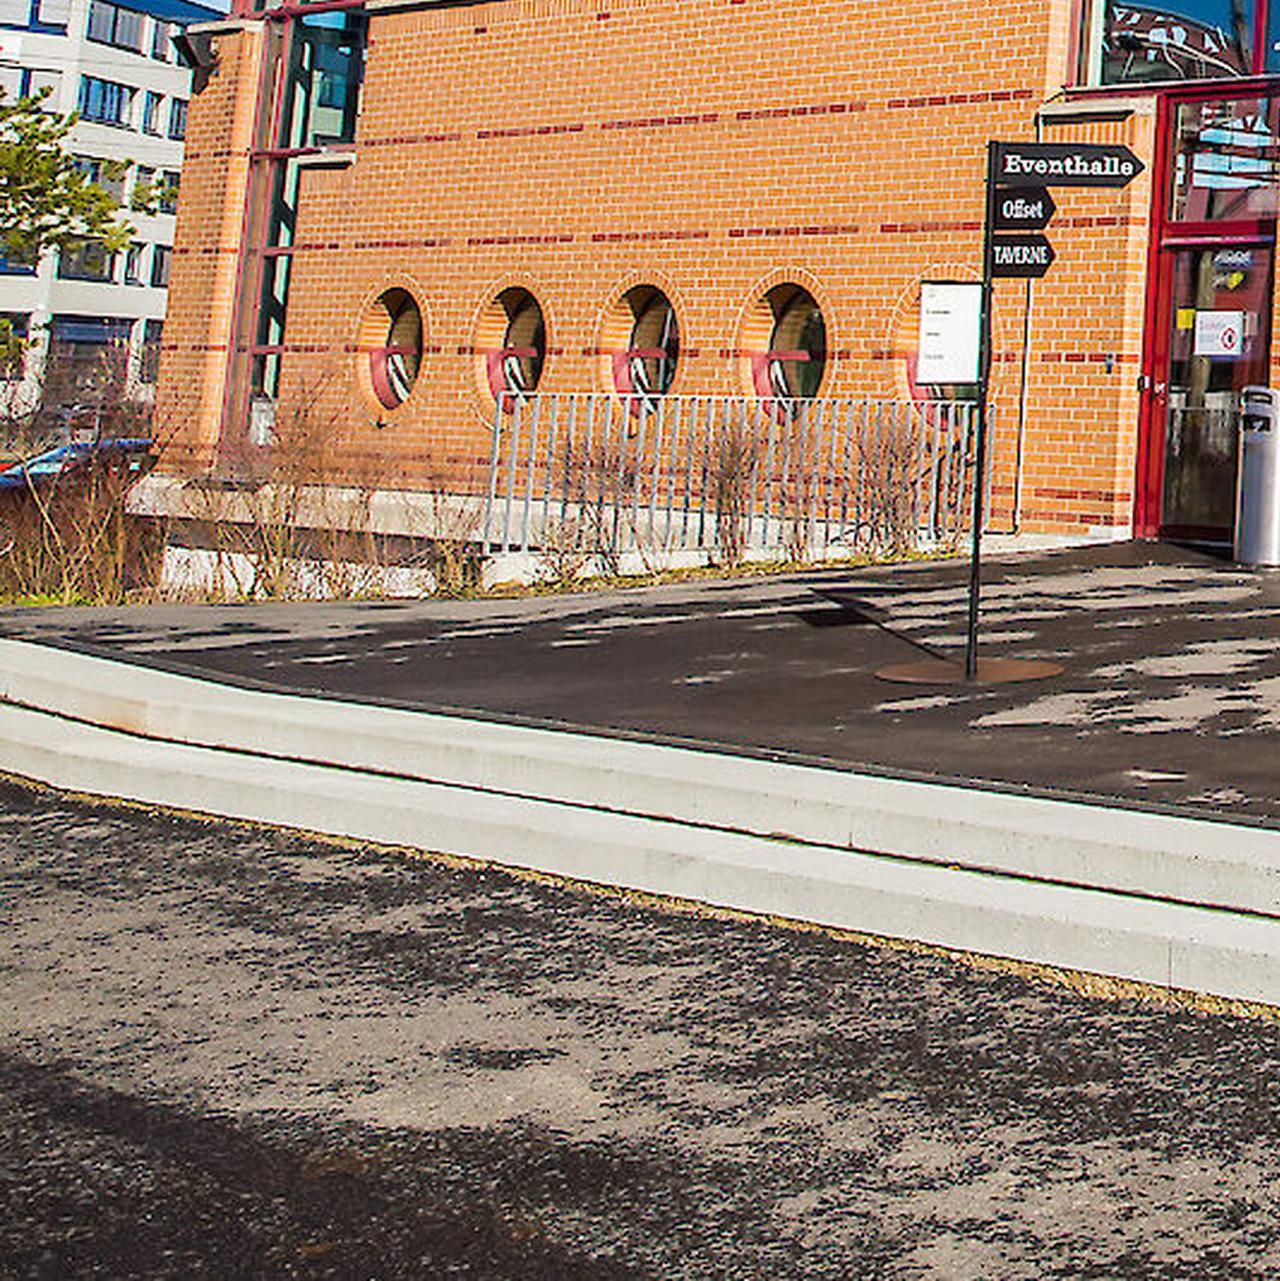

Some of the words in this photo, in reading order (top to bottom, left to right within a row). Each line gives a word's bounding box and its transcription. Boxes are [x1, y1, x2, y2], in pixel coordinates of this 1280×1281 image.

[1003, 154, 1134, 176] Eventhalle
[1002, 199, 1043, 218] Offset
[994, 245, 1048, 264] TAVERNE
